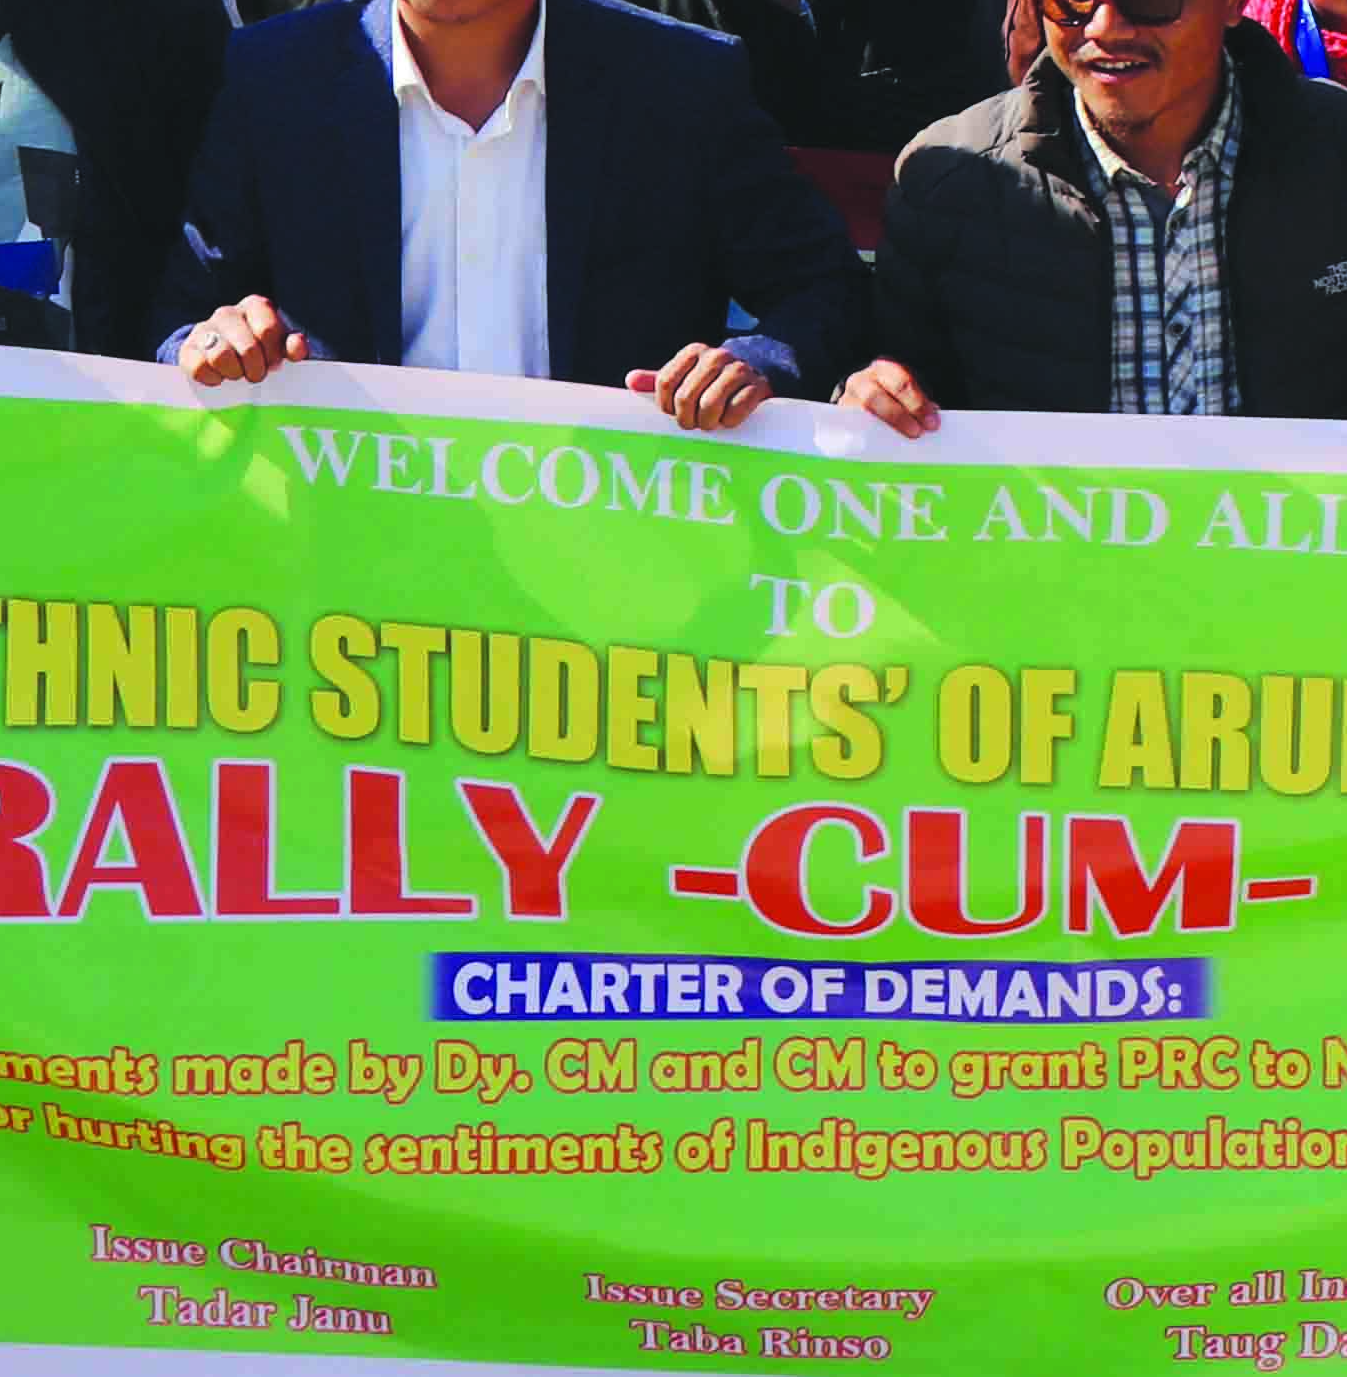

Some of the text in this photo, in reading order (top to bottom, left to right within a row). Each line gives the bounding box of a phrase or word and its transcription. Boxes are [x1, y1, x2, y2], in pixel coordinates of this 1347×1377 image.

[278, 424, 739, 528] WELCOME
[759, 468, 952, 547] ONE
[973, 480, 1174, 550] AND
[749, 568, 879, 642] TO
[936, 660, 1078, 792] OF
[667, 801, 1320, 944] -CUM-
[450, 955, 1185, 1020] CHARTER OF DEMANDS:
[171, 1040, 336, 1096] made
[349, 1040, 422, 1105] by
[434, 1039, 532, 1104] Dy.
[544, 1037, 638, 1094] CM
[650, 1037, 760, 1092] and
[774, 1036, 866, 1092] CM
[878, 1040, 938, 1091] to
[949, 1041, 1107, 1098] grant
[1118, 1035, 1240, 1090] PRC
[1250, 1038, 1311, 1089] to
[44, 1102, 246, 1170] hurting
[258, 1121, 352, 1174] the
[364, 1122, 663, 1175] sentiments
[674, 1118, 735, 1172] of
[746, 1116, 1049, 1180] Indigenous
[90, 1224, 439, 1290] Issue Chairman
[138, 1284, 394, 1336] Tadar Janu
[583, 1272, 937, 1320] Issue Secretary
[1104, 1277, 1215, 1312] Over
[1228, 1270, 1285, 1307] all
[629, 1318, 893, 1363] Taba Rinso
[1164, 1324, 1287, 1370] Taug
